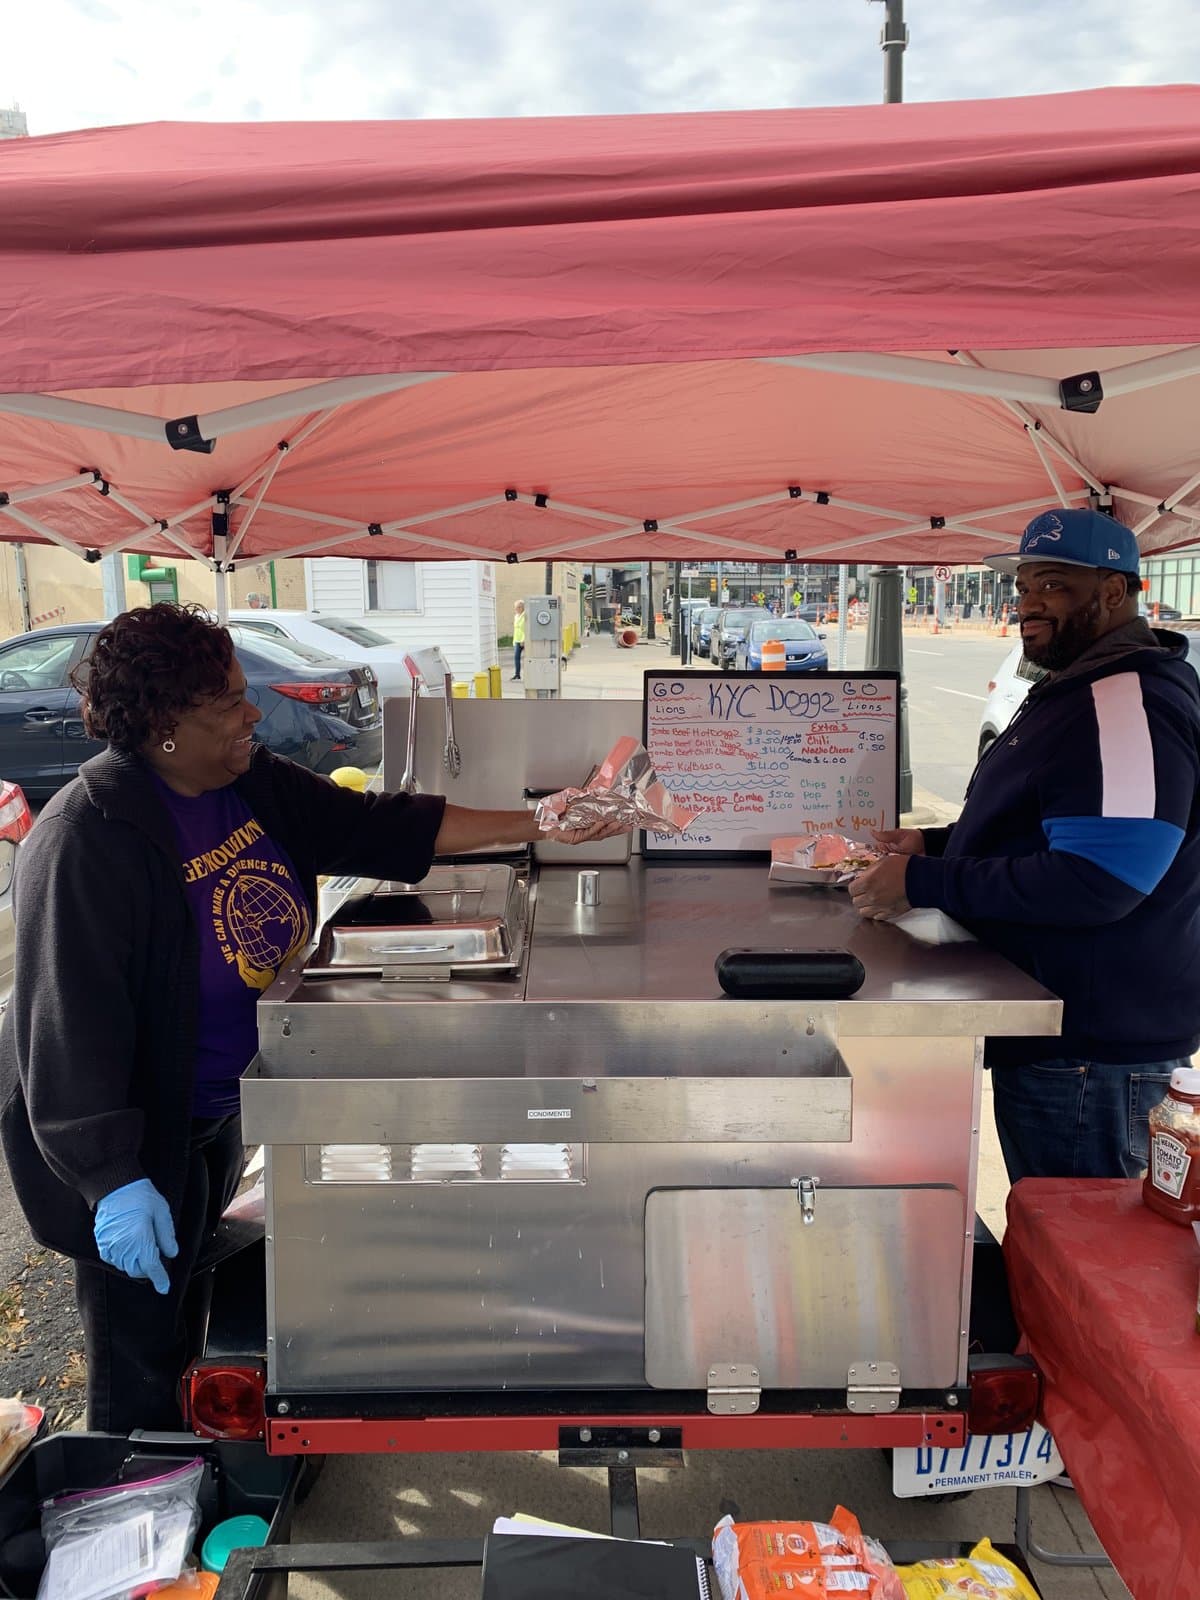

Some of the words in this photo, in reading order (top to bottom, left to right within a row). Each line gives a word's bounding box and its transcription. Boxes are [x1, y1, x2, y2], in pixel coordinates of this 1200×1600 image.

[653, 682, 685, 697] GO
[842, 681, 878, 696] GO
[708, 682, 761, 720] KYC
[847, 701, 882, 711] Lions
[656, 704, 686, 715] Lions
[806, 735, 830, 746] Chili
[800, 778, 827, 789] Chips
[673, 793, 690, 803] Hot
[733, 791, 764, 803] Combo
[733, 803, 764, 813] Combo
[801, 816, 846, 833] Thank
[681, 832, 712, 844] Chips
[219, 877, 231, 888] A
[212, 886, 225, 916] MAKE
[213, 919, 227, 942] CAN
[220, 943, 236, 965] WE
[528, 1110, 570, 1118] CONDIMENTS
[1160, 1138, 1179, 1152] HEINZ
[1156, 1146, 1182, 1166] TOMATO
[935, 1473, 990, 1487] PERMANENT
[993, 1470, 1033, 1482] TRAILER
